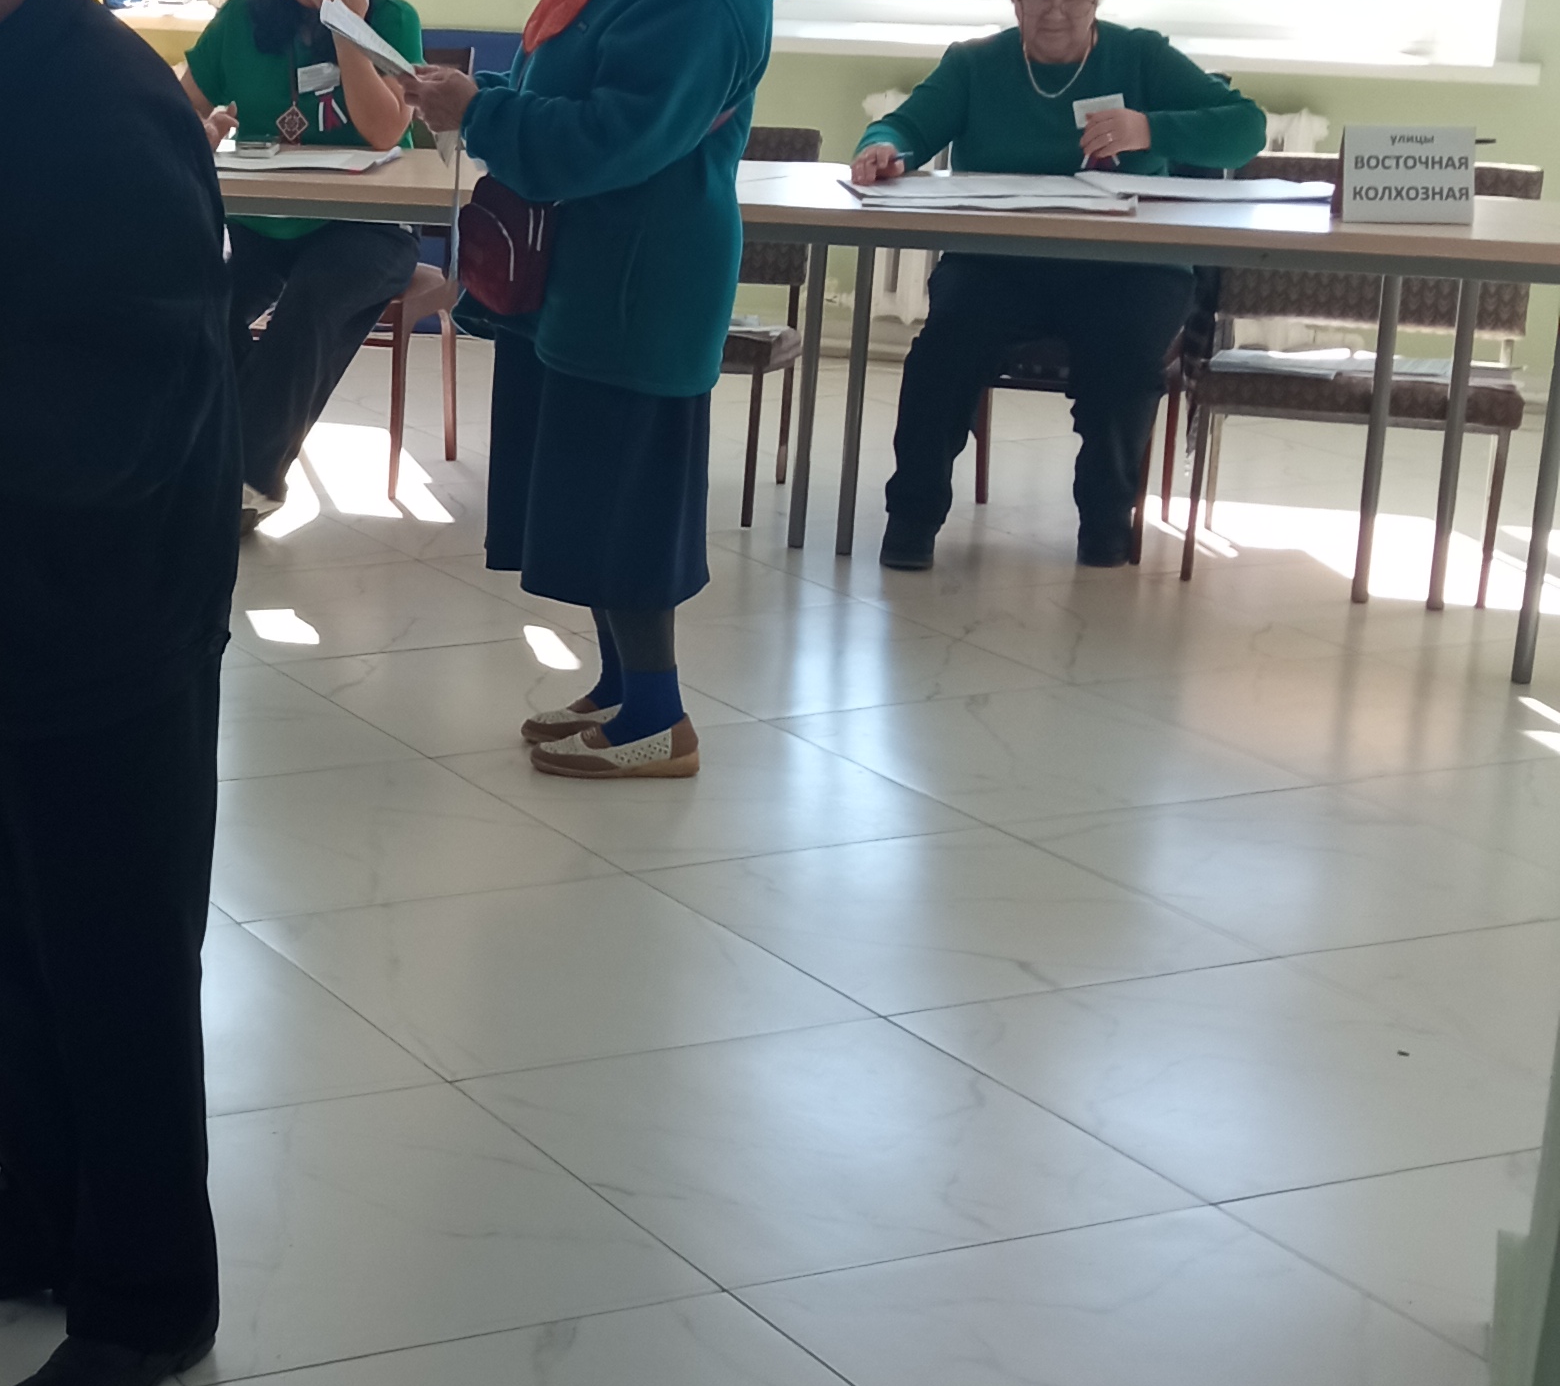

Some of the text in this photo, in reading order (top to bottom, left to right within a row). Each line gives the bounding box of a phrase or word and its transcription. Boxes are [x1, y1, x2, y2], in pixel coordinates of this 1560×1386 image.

[1389, 133, 1435, 146] улицы
[1353, 154, 1470, 171] ВОСТОЧНАЯ
[1351, 185, 1470, 202] КОЛХОЗНАЯ
